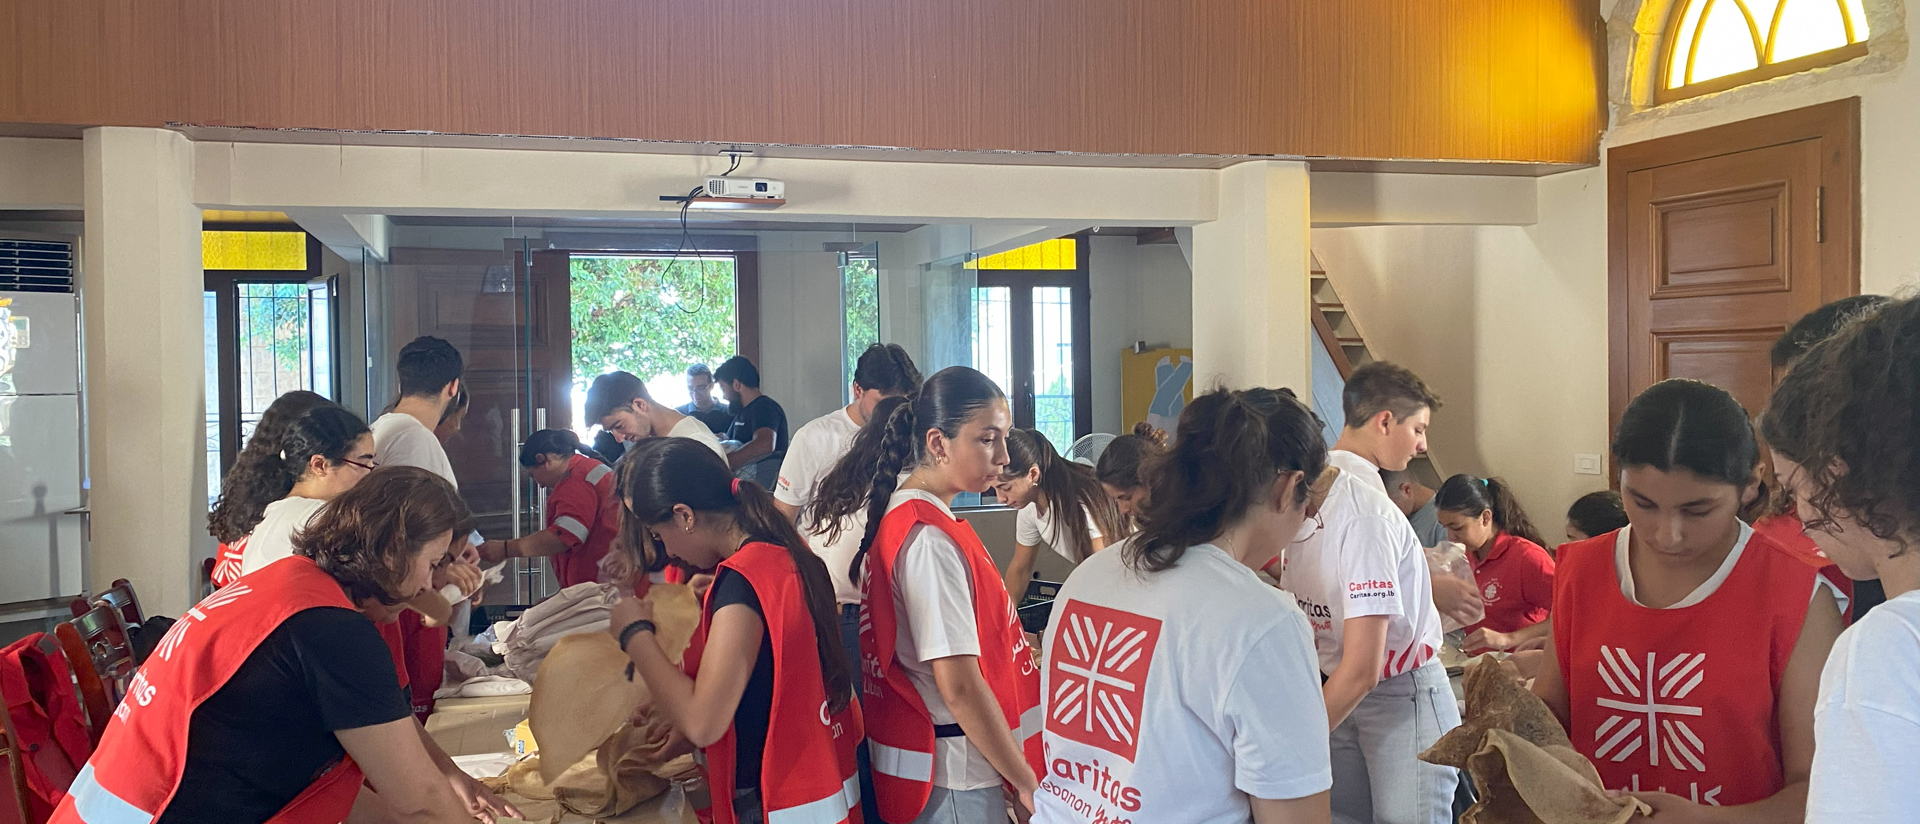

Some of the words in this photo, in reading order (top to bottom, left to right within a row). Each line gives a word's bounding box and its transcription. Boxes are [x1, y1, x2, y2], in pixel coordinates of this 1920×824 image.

[1349, 579, 1394, 592] Caritas
[1350, 590, 1395, 599] Caritas.org.lb
[1045, 741, 1142, 812] aritas
[1040, 781, 1092, 818] ebanon
